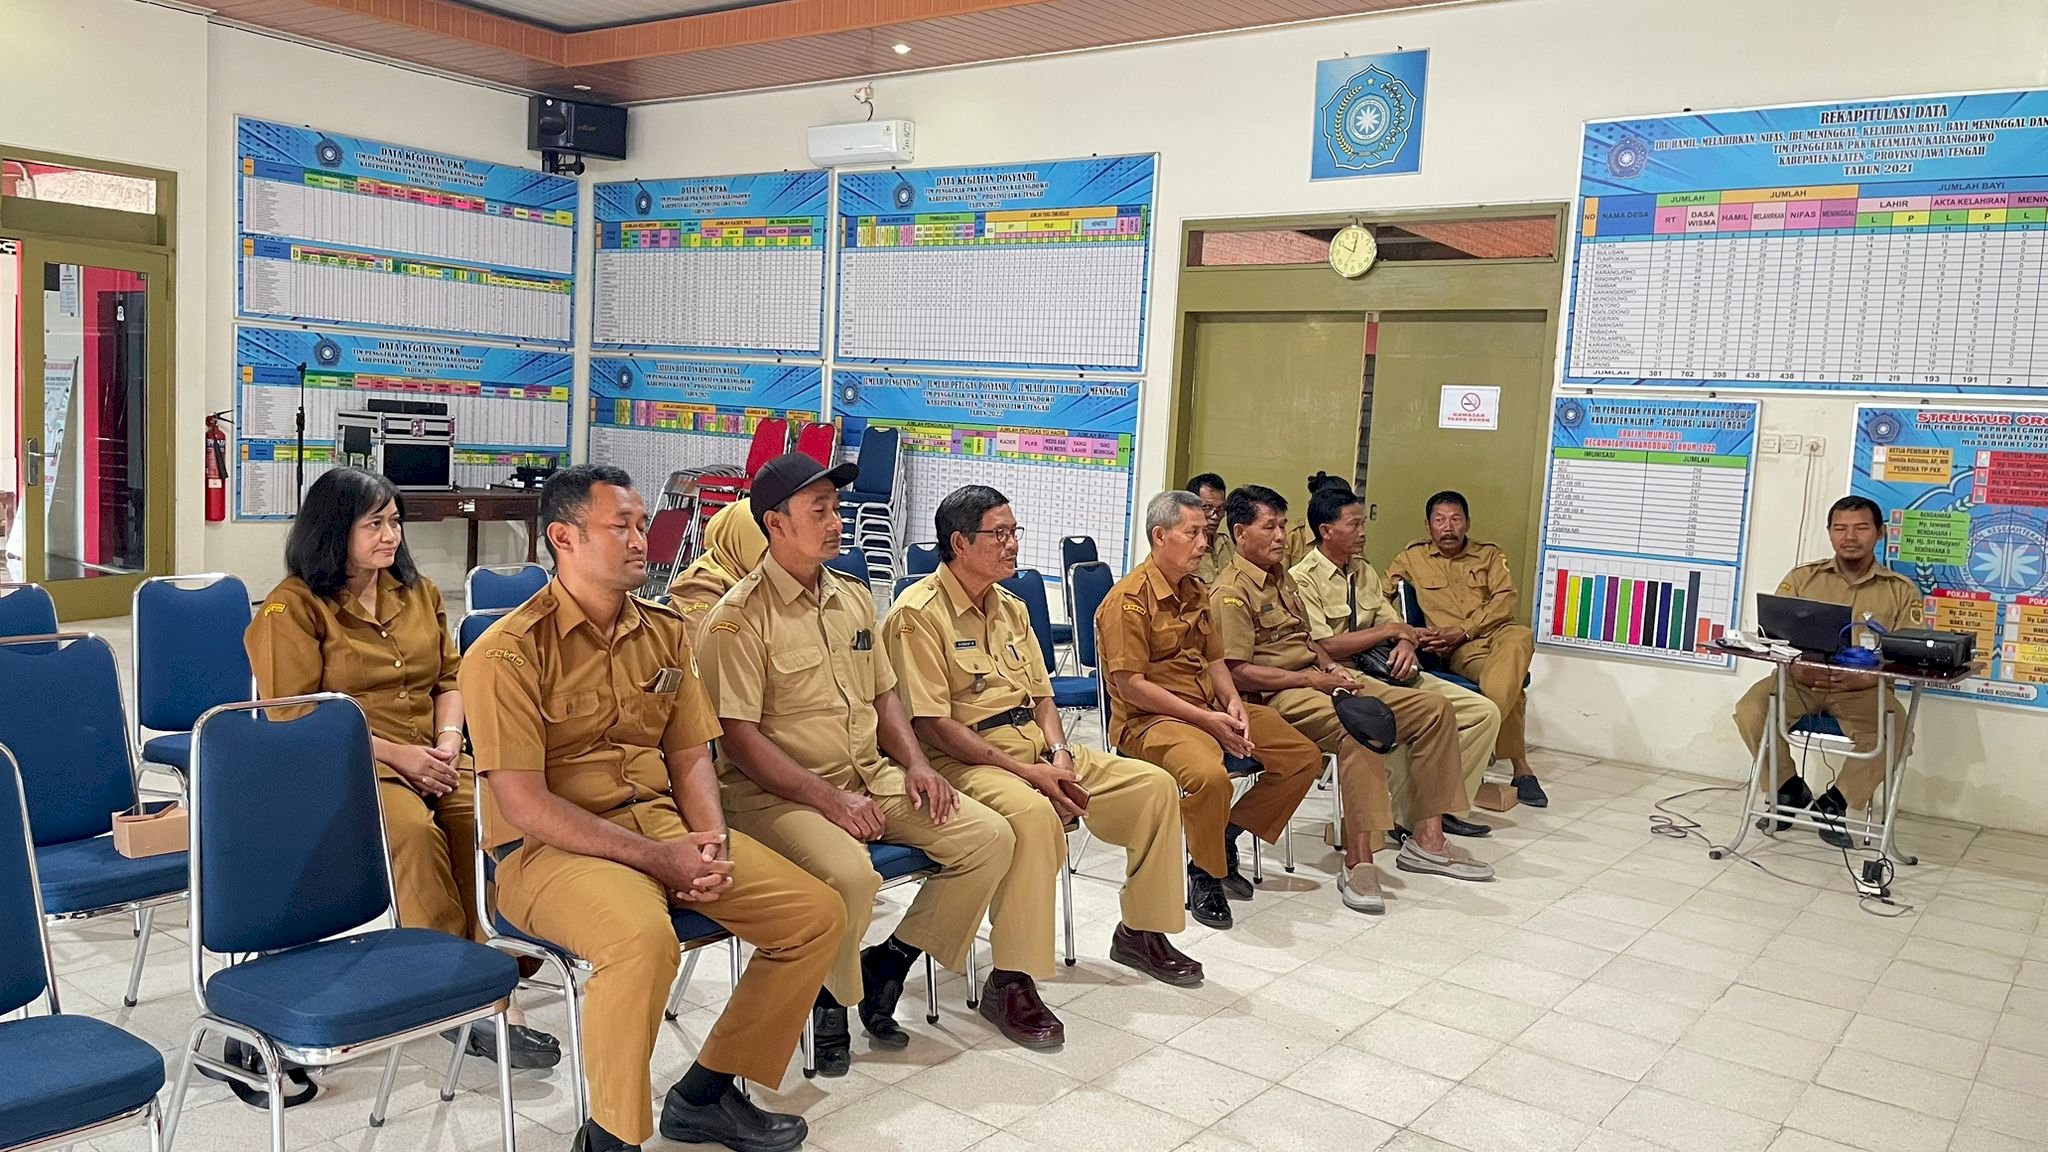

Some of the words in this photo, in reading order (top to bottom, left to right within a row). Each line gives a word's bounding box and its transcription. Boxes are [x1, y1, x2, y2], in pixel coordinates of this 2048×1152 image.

[1821, 106, 1910, 124] REKAPITULASI
[1915, 104, 1948, 118] DATA
[1655, 141, 1669, 150] IBU
[1789, 131, 1804, 142] IBU
[1863, 124, 1915, 136] KELAHIRAN
[1946, 121, 1968, 132] BAYI
[1971, 118, 2026, 130] MENINGGAL
[2029, 116, 2048, 127] DAN
[1773, 144, 1788, 154] TIM
[1791, 140, 1844, 153] PENGGERAK
[1847, 139, 1866, 150] PKK
[1870, 136, 1922, 148] KECAMATAN
[1925, 132, 1995, 145] KARANGDOWO
[382, 148, 402, 159] DATA
[405, 151, 445, 166] KEGIATAN
[447, 160, 465, 170] PKK
[1779, 154, 1830, 166] KABUPATEN
[1831, 152, 1865, 162] KLATEN
[1874, 149, 1918, 161] PROVINSI
[1919, 148, 1945, 159] JAWA
[1948, 146, 1986, 157] TENGAH
[1843, 166, 1880, 176] TAHUN
[1884, 164, 1912, 174] 2021
[1982, 182, 2005, 190] BAYI
[1671, 195, 1705, 203] JUMLAH
[1770, 190, 1806, 199] JUMLAH
[1880, 200, 1909, 209] LAHIR
[1958, 197, 2006, 205] KELAHIRAN
[1665, 216, 1676, 224] RT
[1688, 219, 1716, 227] WISMA
[379, 342, 400, 350] DATA
[402, 343, 442, 354] KEGIATAN
[444, 347, 461, 355] PKK
[1917, 412, 2012, 425] STRUKTUR
